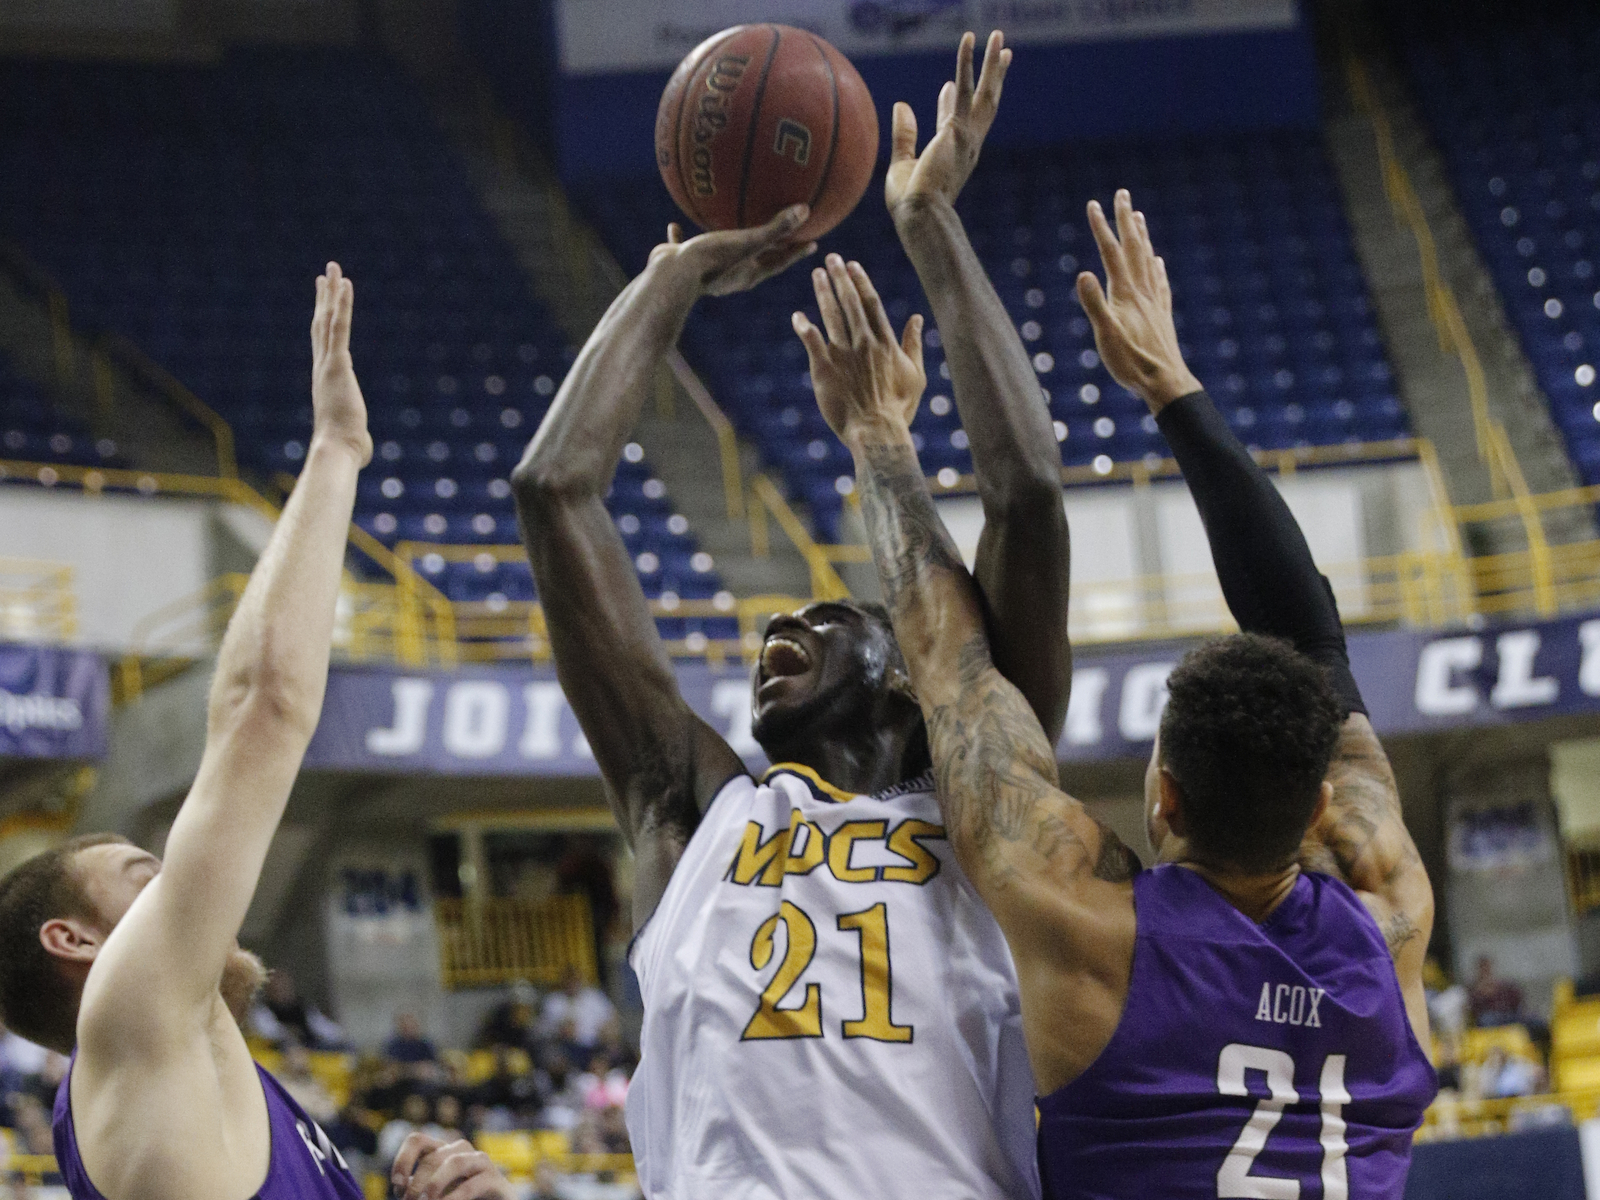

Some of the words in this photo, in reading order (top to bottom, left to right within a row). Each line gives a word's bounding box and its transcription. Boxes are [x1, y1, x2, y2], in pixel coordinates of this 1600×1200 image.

[692, 54, 754, 197] Wilson
[365, 678, 594, 760] JOI
[722, 807, 948, 888] MOCS
[739, 899, 914, 1044] 21
[1255, 982, 1325, 1028] ACOX
